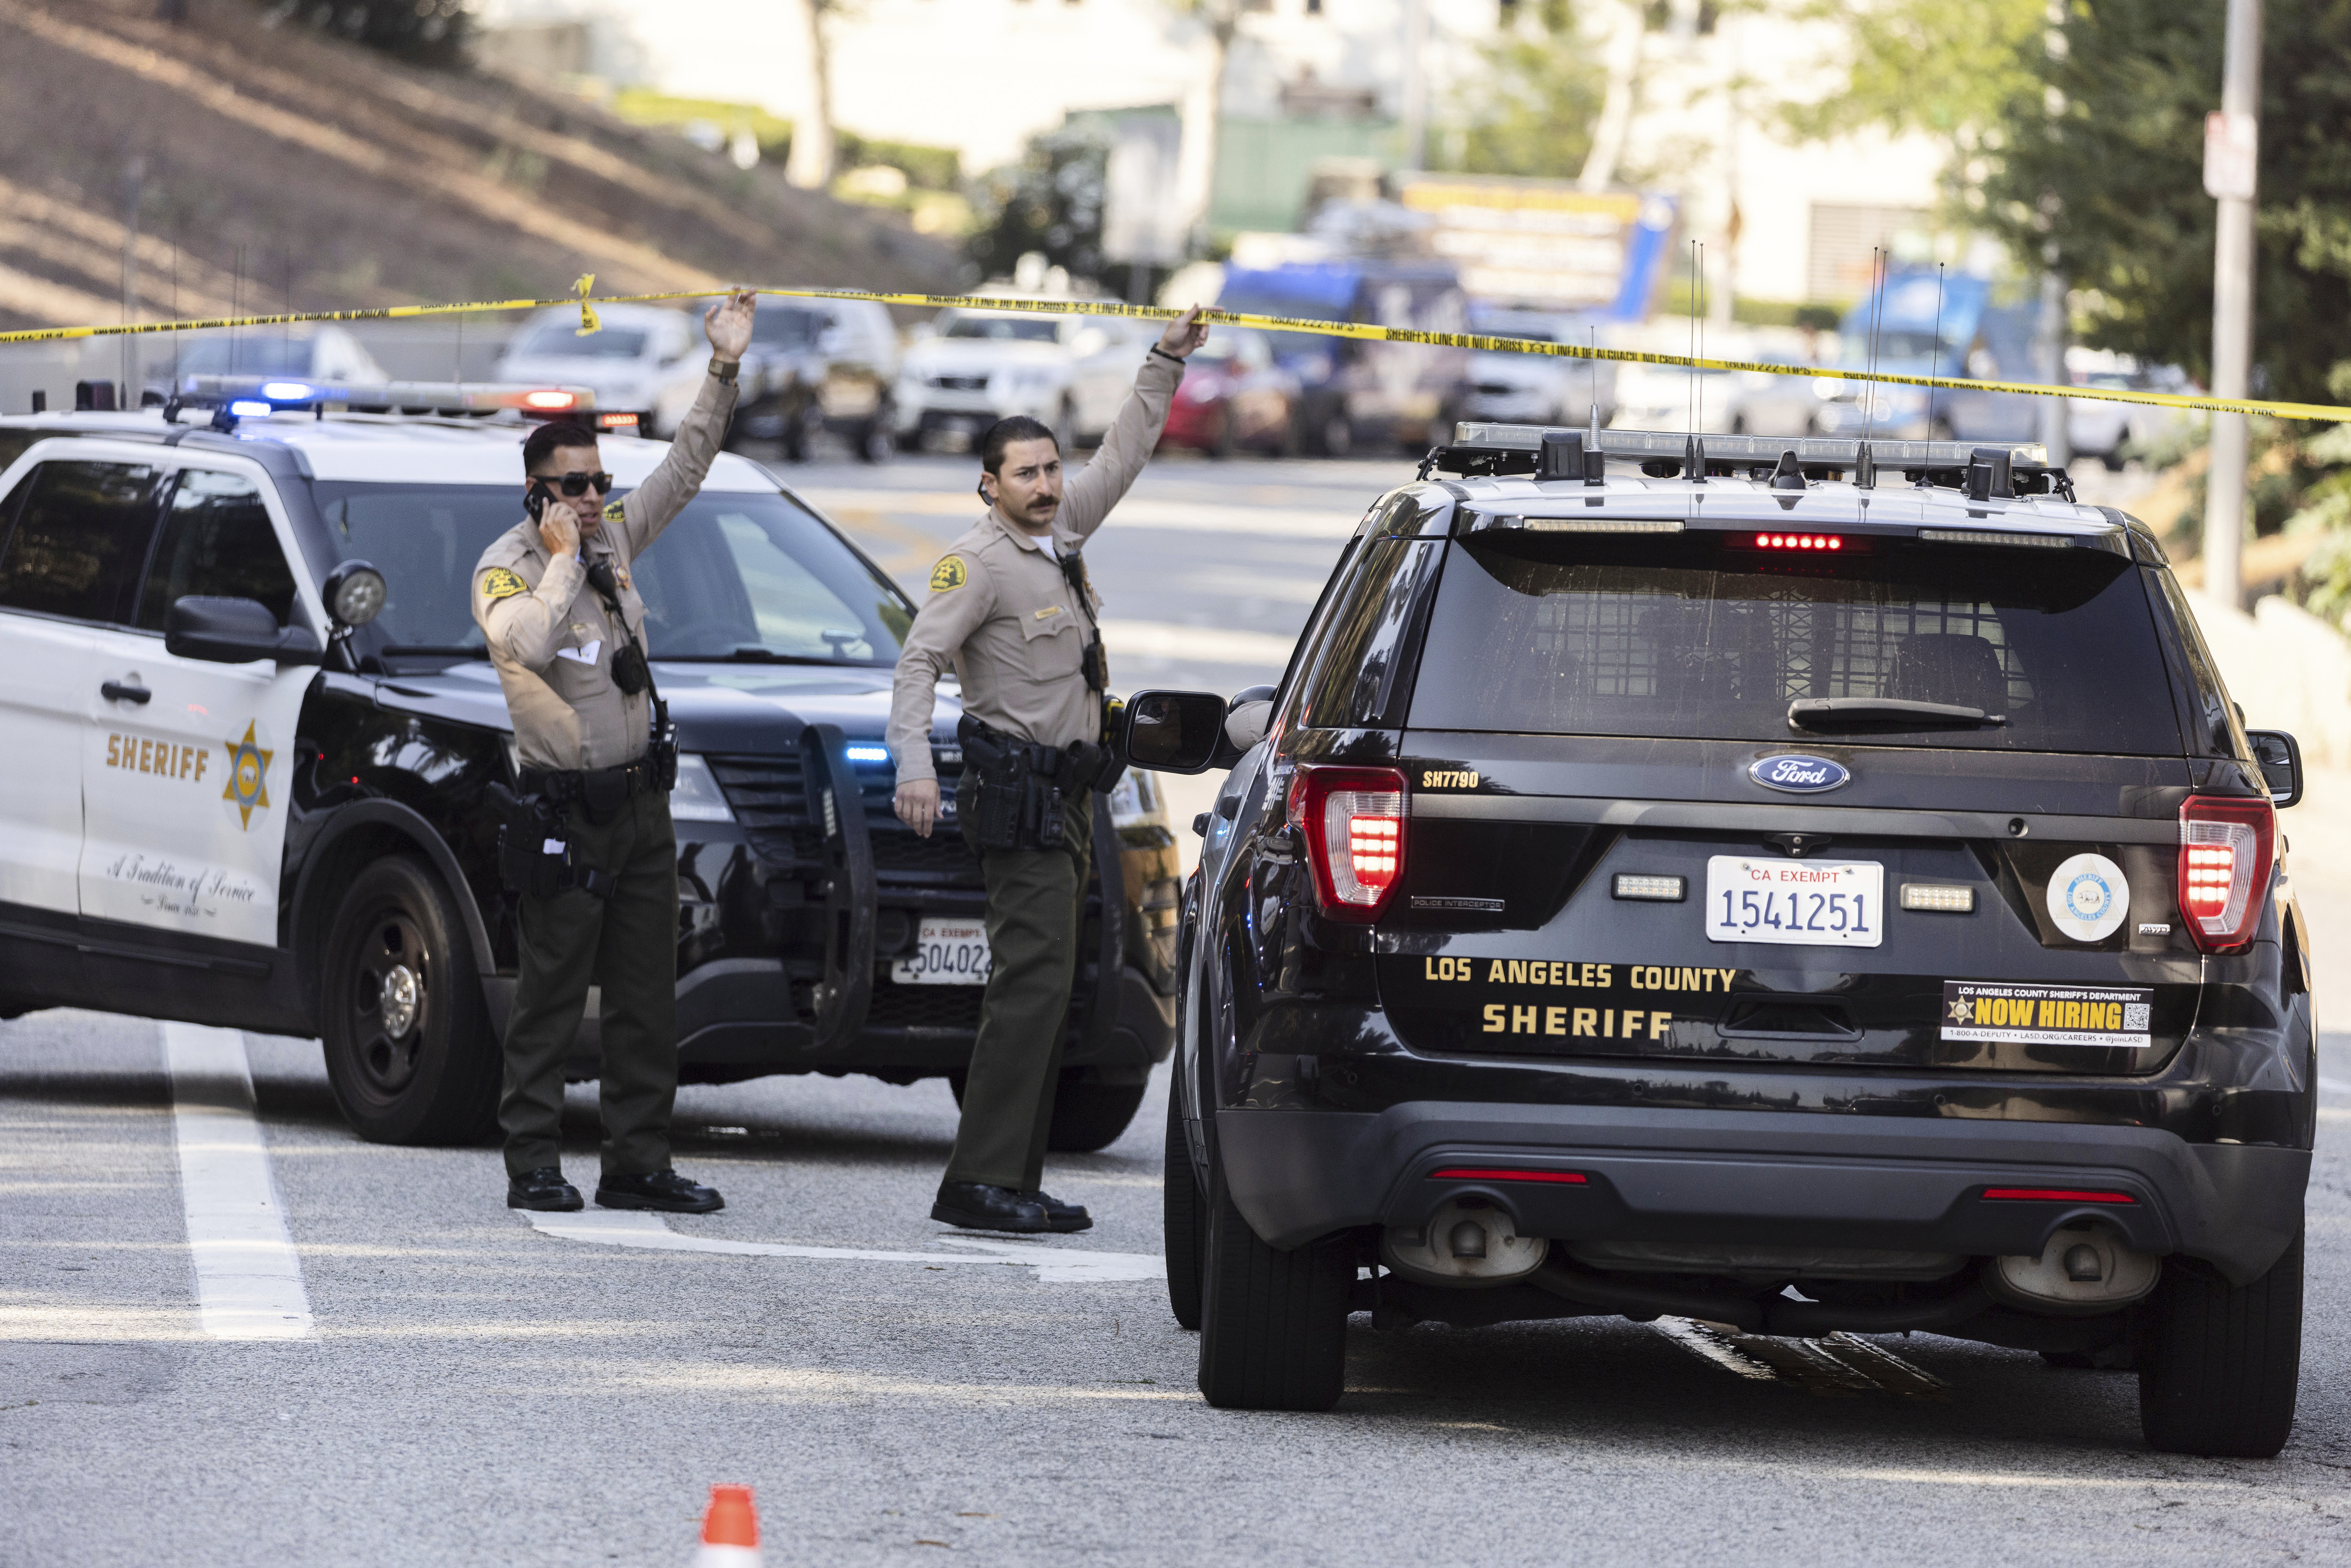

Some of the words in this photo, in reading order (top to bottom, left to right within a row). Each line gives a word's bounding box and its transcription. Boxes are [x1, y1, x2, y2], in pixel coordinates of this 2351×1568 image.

[1387, 327, 1430, 343] SHERIFF'S
[1434, 331, 1454, 346] LINE
[1458, 333, 1469, 347] DO
[1473, 335, 1490, 349] NOT
[1494, 337, 1523, 352] CROSS
[1553, 343, 1578, 357] LINEA
[107, 733, 208, 781] SHERIFF
[1422, 771, 1479, 788] SH7790
[1772, 760, 1825, 784] Ford
[107, 853, 128, 878] A
[126, 853, 185, 890] Tradition
[1751, 870, 1771, 881] CA
[1781, 871, 1839, 883] EXEMPT
[2075, 875, 2103, 885] SHERIFF
[1720, 890, 1870, 932] 1541251
[2070, 906, 2096, 920] ANGELES
[2096, 891, 2109, 919] COUNTY
[922, 928, 935, 937] CA
[941, 928, 981, 938] EXEMPT
[1426, 956, 1471, 981] LOS
[1489, 959, 1611, 987] ANGELES
[1631, 966, 1736, 992] COUNTY
[1976, 987, 2012, 996] ANGELES
[2014, 989, 2048, 998] COUNTY
[2050, 991, 2087, 1000] SHERIFF'S
[2089, 993, 2141, 1001] DEPARTMENT
[1483, 1004, 1673, 1040] SHERIFF
[1974, 998, 2035, 1026] NOW
[2038, 1001, 2122, 1030] HIRING
[1950, 1030, 2011, 1039] 1-800-A-DEPUTY
[2020, 1032, 2097, 1042] LASD.ORG/CAREERS
